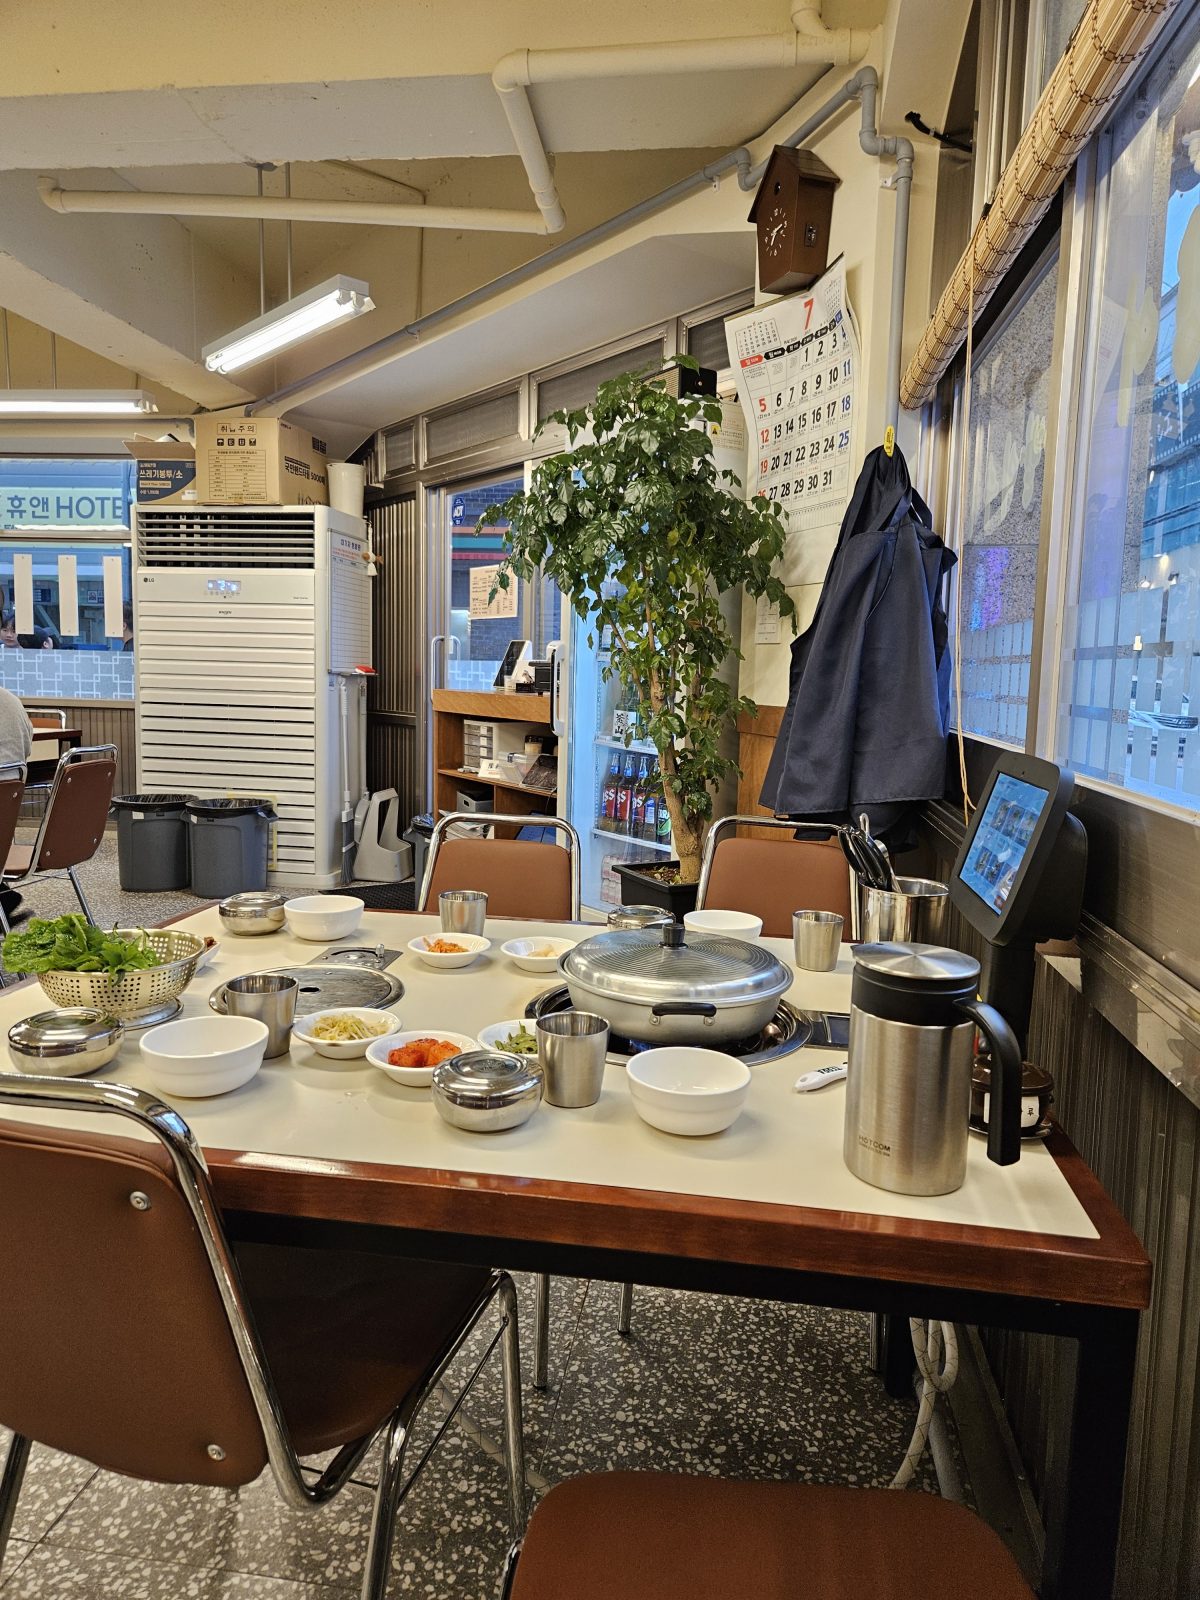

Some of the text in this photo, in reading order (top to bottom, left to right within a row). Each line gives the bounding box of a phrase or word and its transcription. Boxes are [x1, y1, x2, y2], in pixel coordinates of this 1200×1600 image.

[804, 298, 814, 331] 7
[804, 347, 809, 362] 1
[818, 340, 824, 356] 2
[832, 332, 837, 349] 3
[840, 324, 847, 340] 4
[758, 358, 851, 413] 5 6 7 8 9 10 11
[760, 428, 770, 444] 12
[773, 424, 782, 439] 13
[785, 418, 794, 434] 14
[798, 412, 807, 429] 15
[811, 406, 822, 424] 16
[826, 400, 837, 418] 17
[841, 394, 851, 413] 18
[760, 430, 850, 474] 19 20 21 22 23 24 25
[139, 469, 183, 479] 쓰레기봉투/소
[768, 485, 778, 501] 27
[780, 482, 791, 498] 28
[793, 478, 804, 494] 29
[807, 474, 819, 490] 30
[822, 469, 833, 486] 31
[6, 495, 50, 519] 휴앤
[453, 505, 463, 518] ADT
